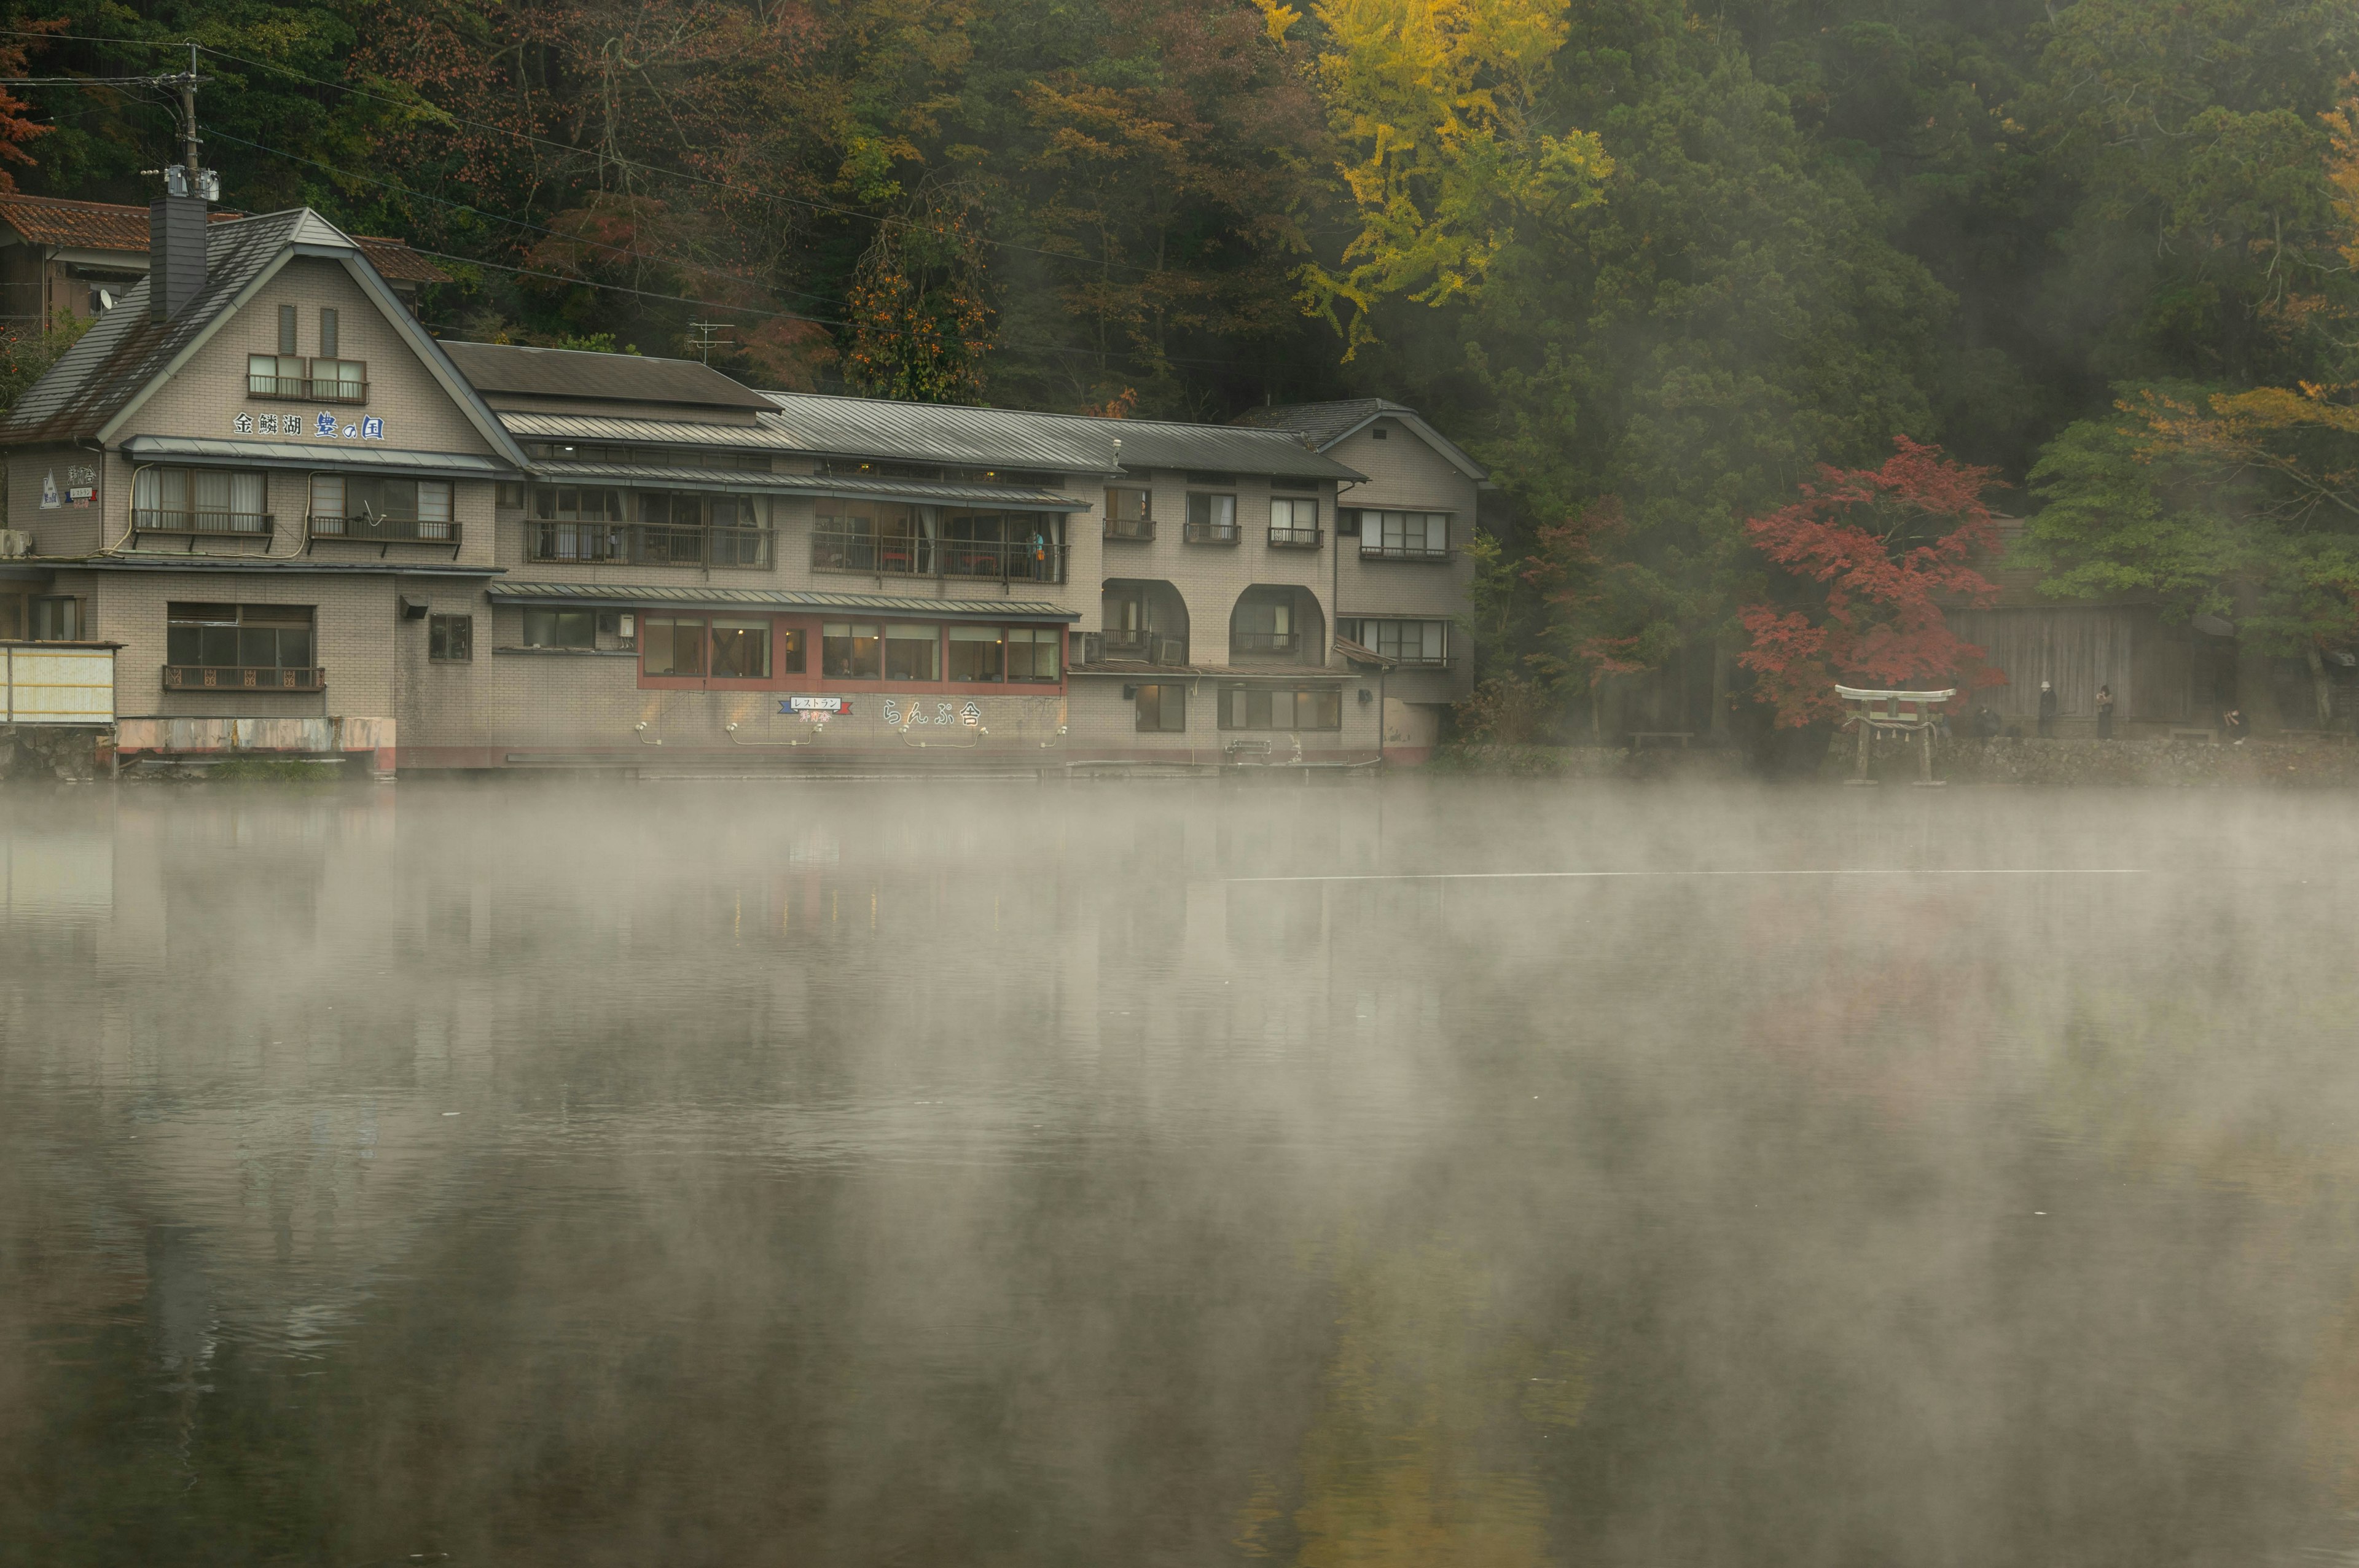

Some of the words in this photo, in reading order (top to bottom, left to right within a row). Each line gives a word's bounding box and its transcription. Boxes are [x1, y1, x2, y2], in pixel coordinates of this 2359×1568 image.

[233, 412, 303, 435] 金鱗湖
[313, 410, 385, 441] 豊の国
[794, 698, 837, 708] レストラン
[883, 700, 981, 726] らんぷ舎
